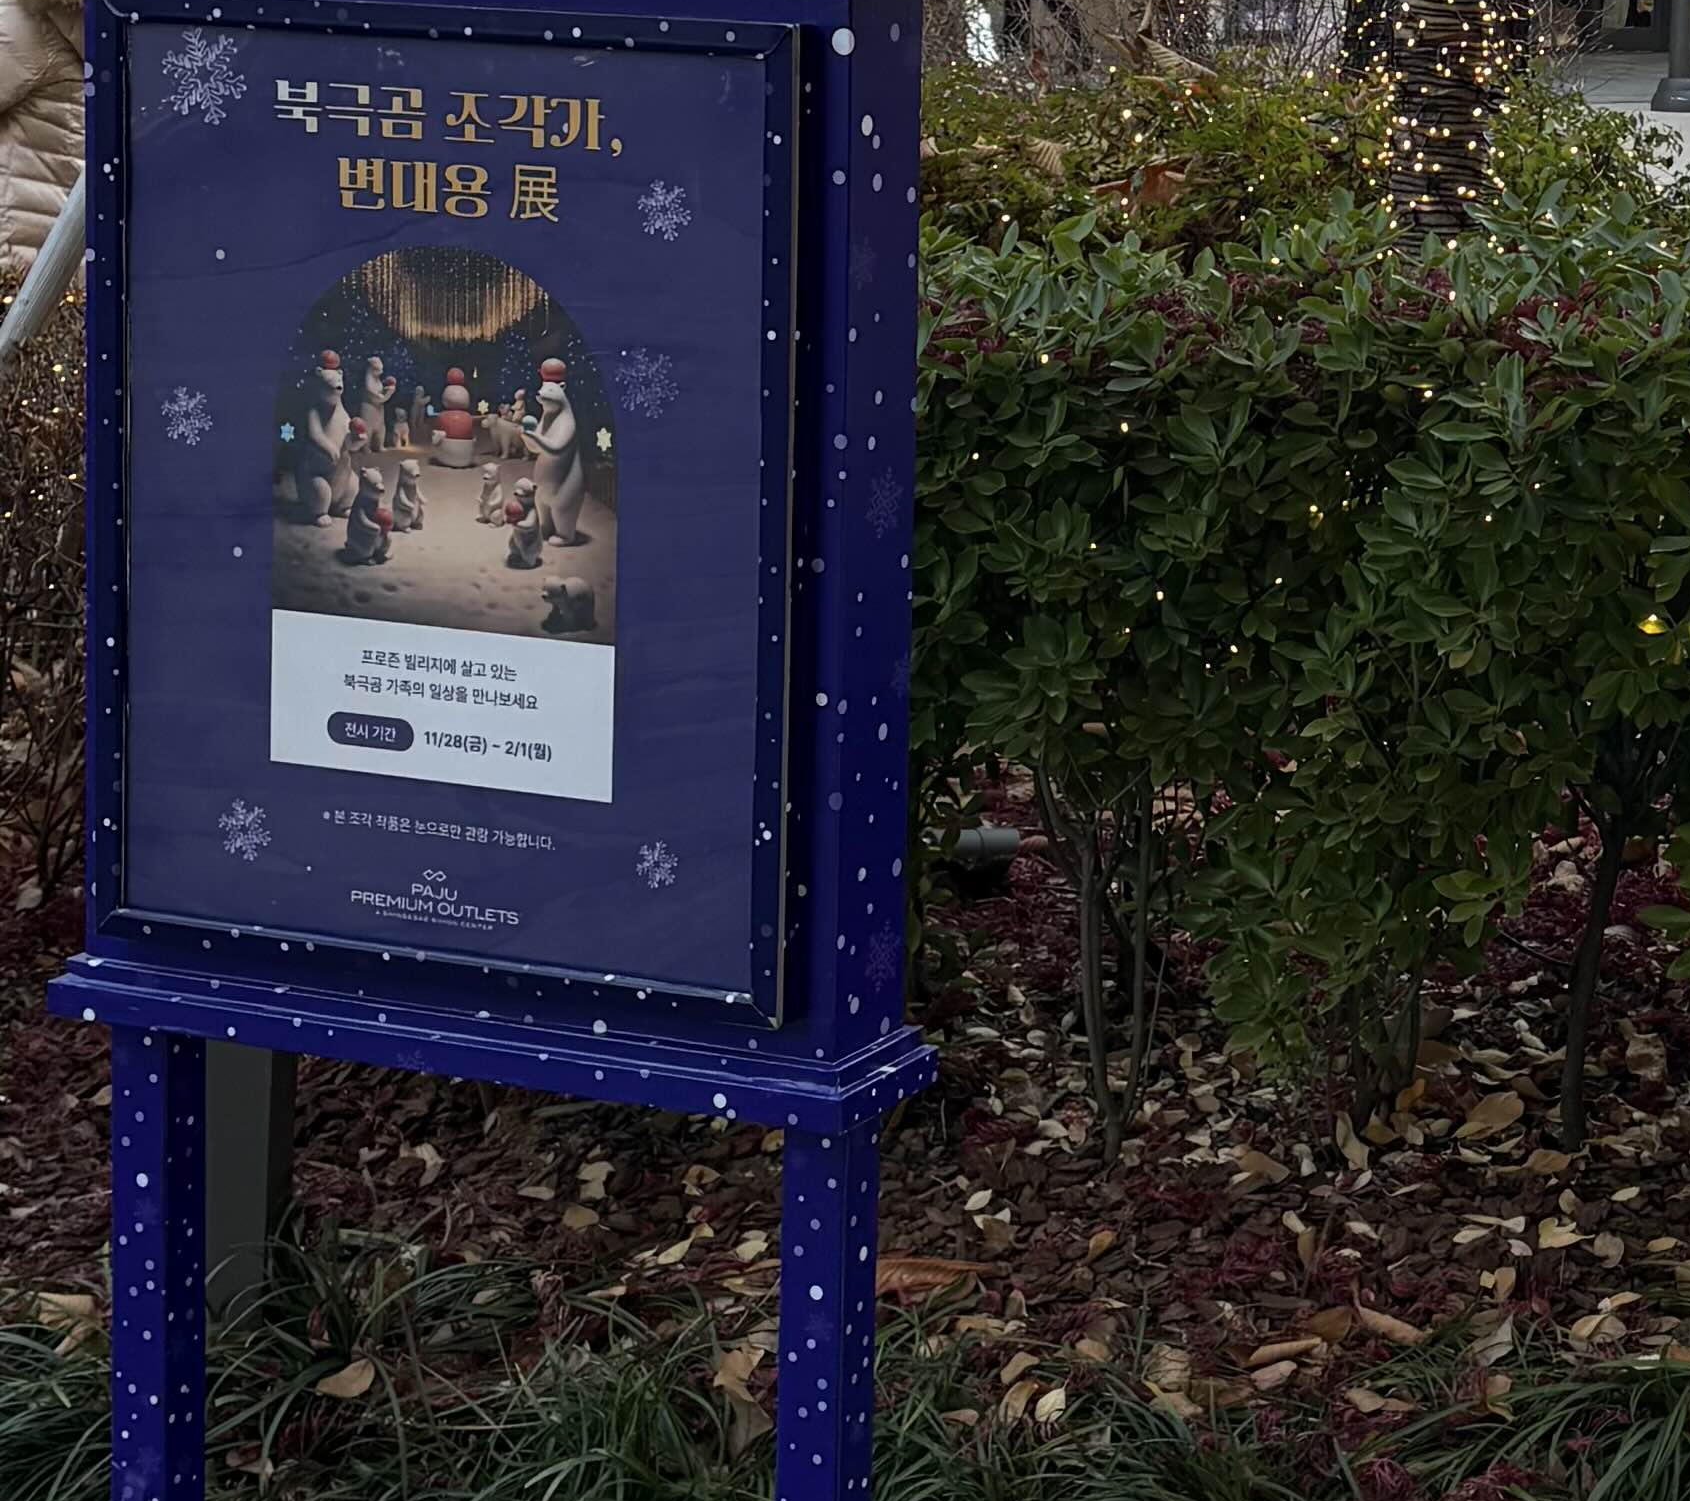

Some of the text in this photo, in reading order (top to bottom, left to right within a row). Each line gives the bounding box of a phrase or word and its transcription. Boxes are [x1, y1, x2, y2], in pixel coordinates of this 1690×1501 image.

[273, 79, 624, 158] 북극곰 조각가,
[336, 156, 560, 223] 변대용 展
[361, 650, 517, 682] 프로즌 빌리지에 살고 있는
[344, 674, 540, 710] 북극곰 가족의 일상을 만나보세요
[344, 721, 398, 744] 전시 기간
[423, 730, 488, 756] 11/28(금)
[349, 811, 372, 829] 조각
[376, 815, 412, 834] 작품은
[415, 820, 461, 841] 눈으로만
[465, 826, 489, 844] 관람
[351, 889, 433, 913] PREMIUM
[437, 902, 520, 925] OUTLETS
[411, 883, 458, 901] PAJU
